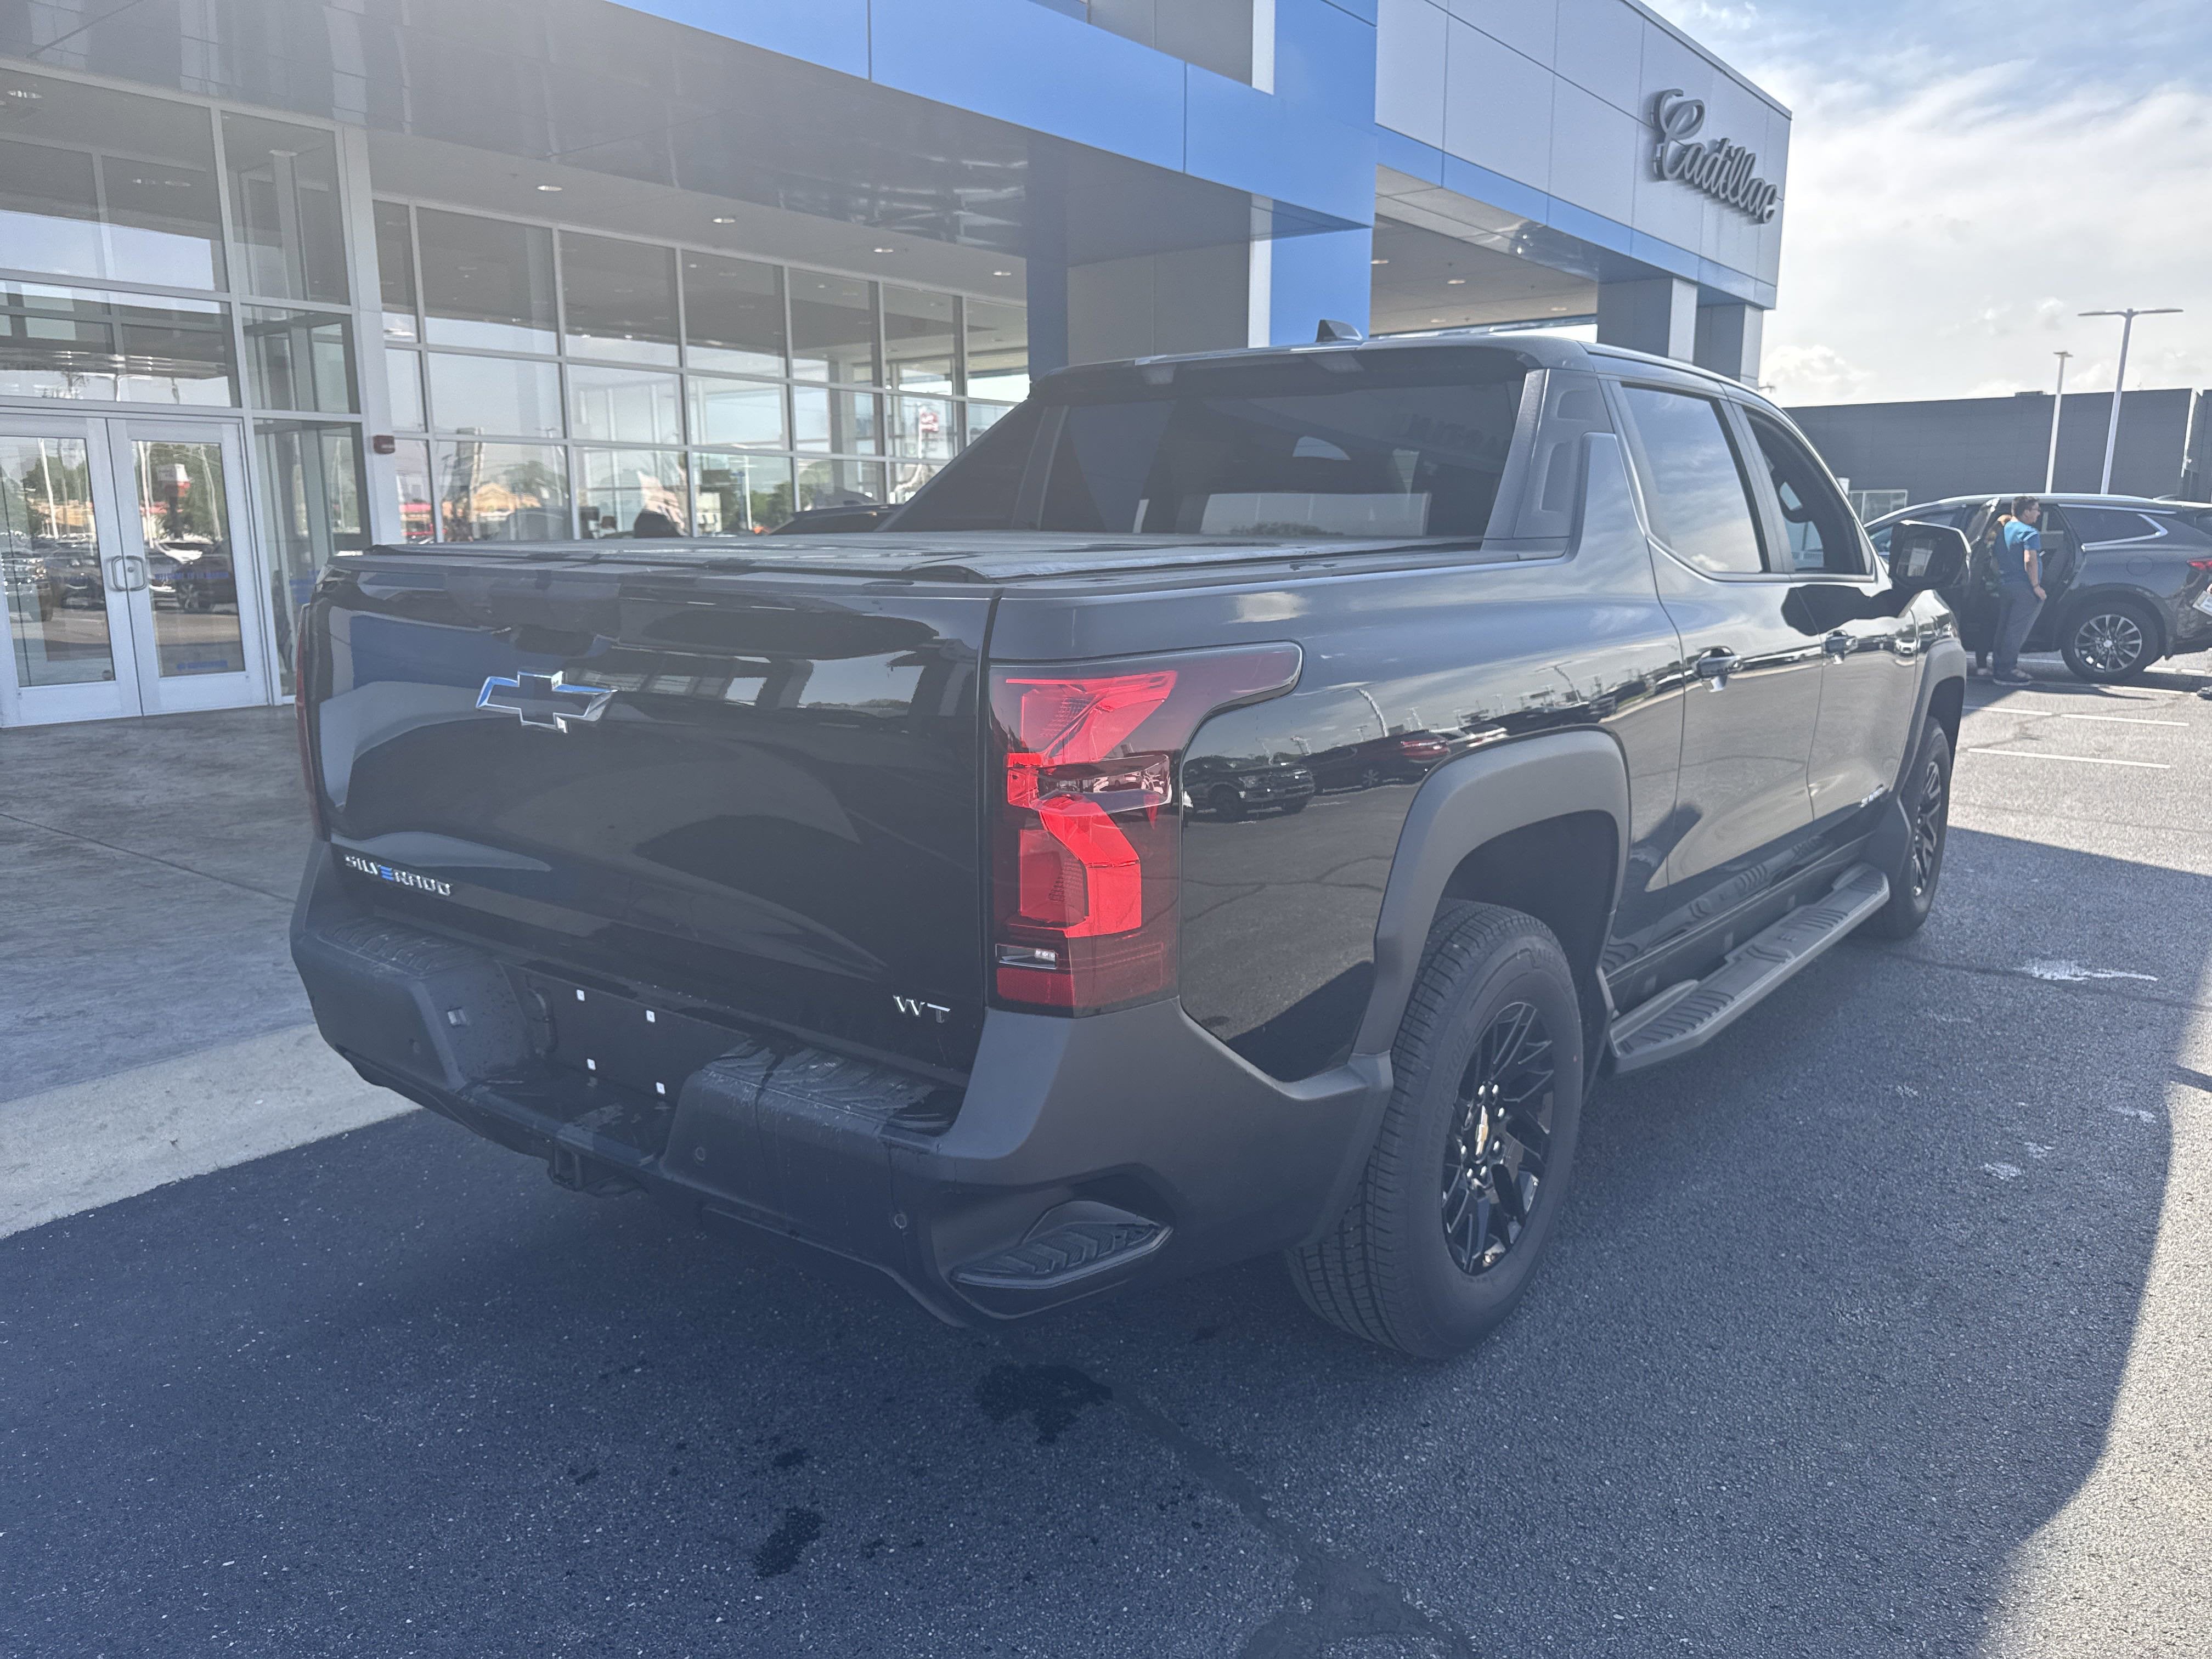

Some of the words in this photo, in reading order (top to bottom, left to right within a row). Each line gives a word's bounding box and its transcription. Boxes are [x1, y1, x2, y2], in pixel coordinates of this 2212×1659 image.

[1652, 88, 1778, 223] Cadillac
[344, 855, 452, 896] SILVERADO
[893, 995, 951, 1023] WT
